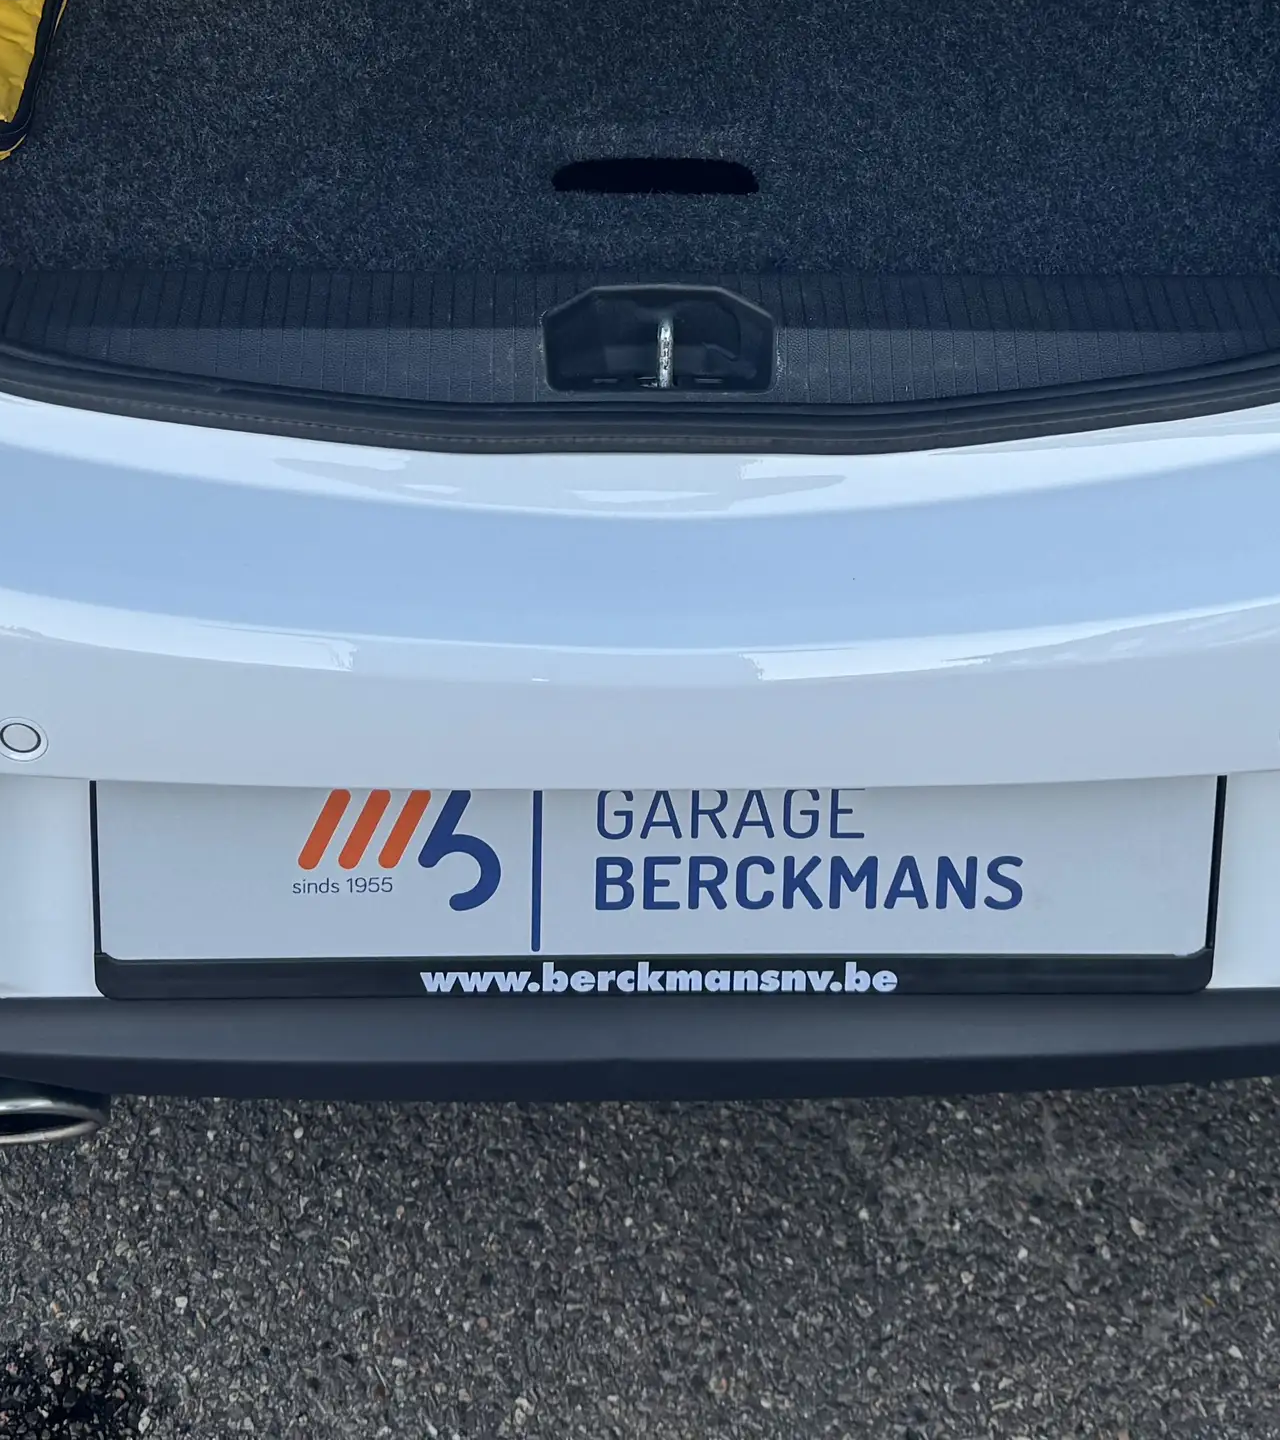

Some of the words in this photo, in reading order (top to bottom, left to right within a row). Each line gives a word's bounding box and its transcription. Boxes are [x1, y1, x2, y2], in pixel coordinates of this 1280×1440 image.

[596, 788, 867, 840] GARAGE
[291, 876, 341, 895] sinds
[346, 876, 394, 894] 1955
[595, 855, 1024, 911] BERCKMANS
[419, 961, 898, 993] www.berckmansnv.be
